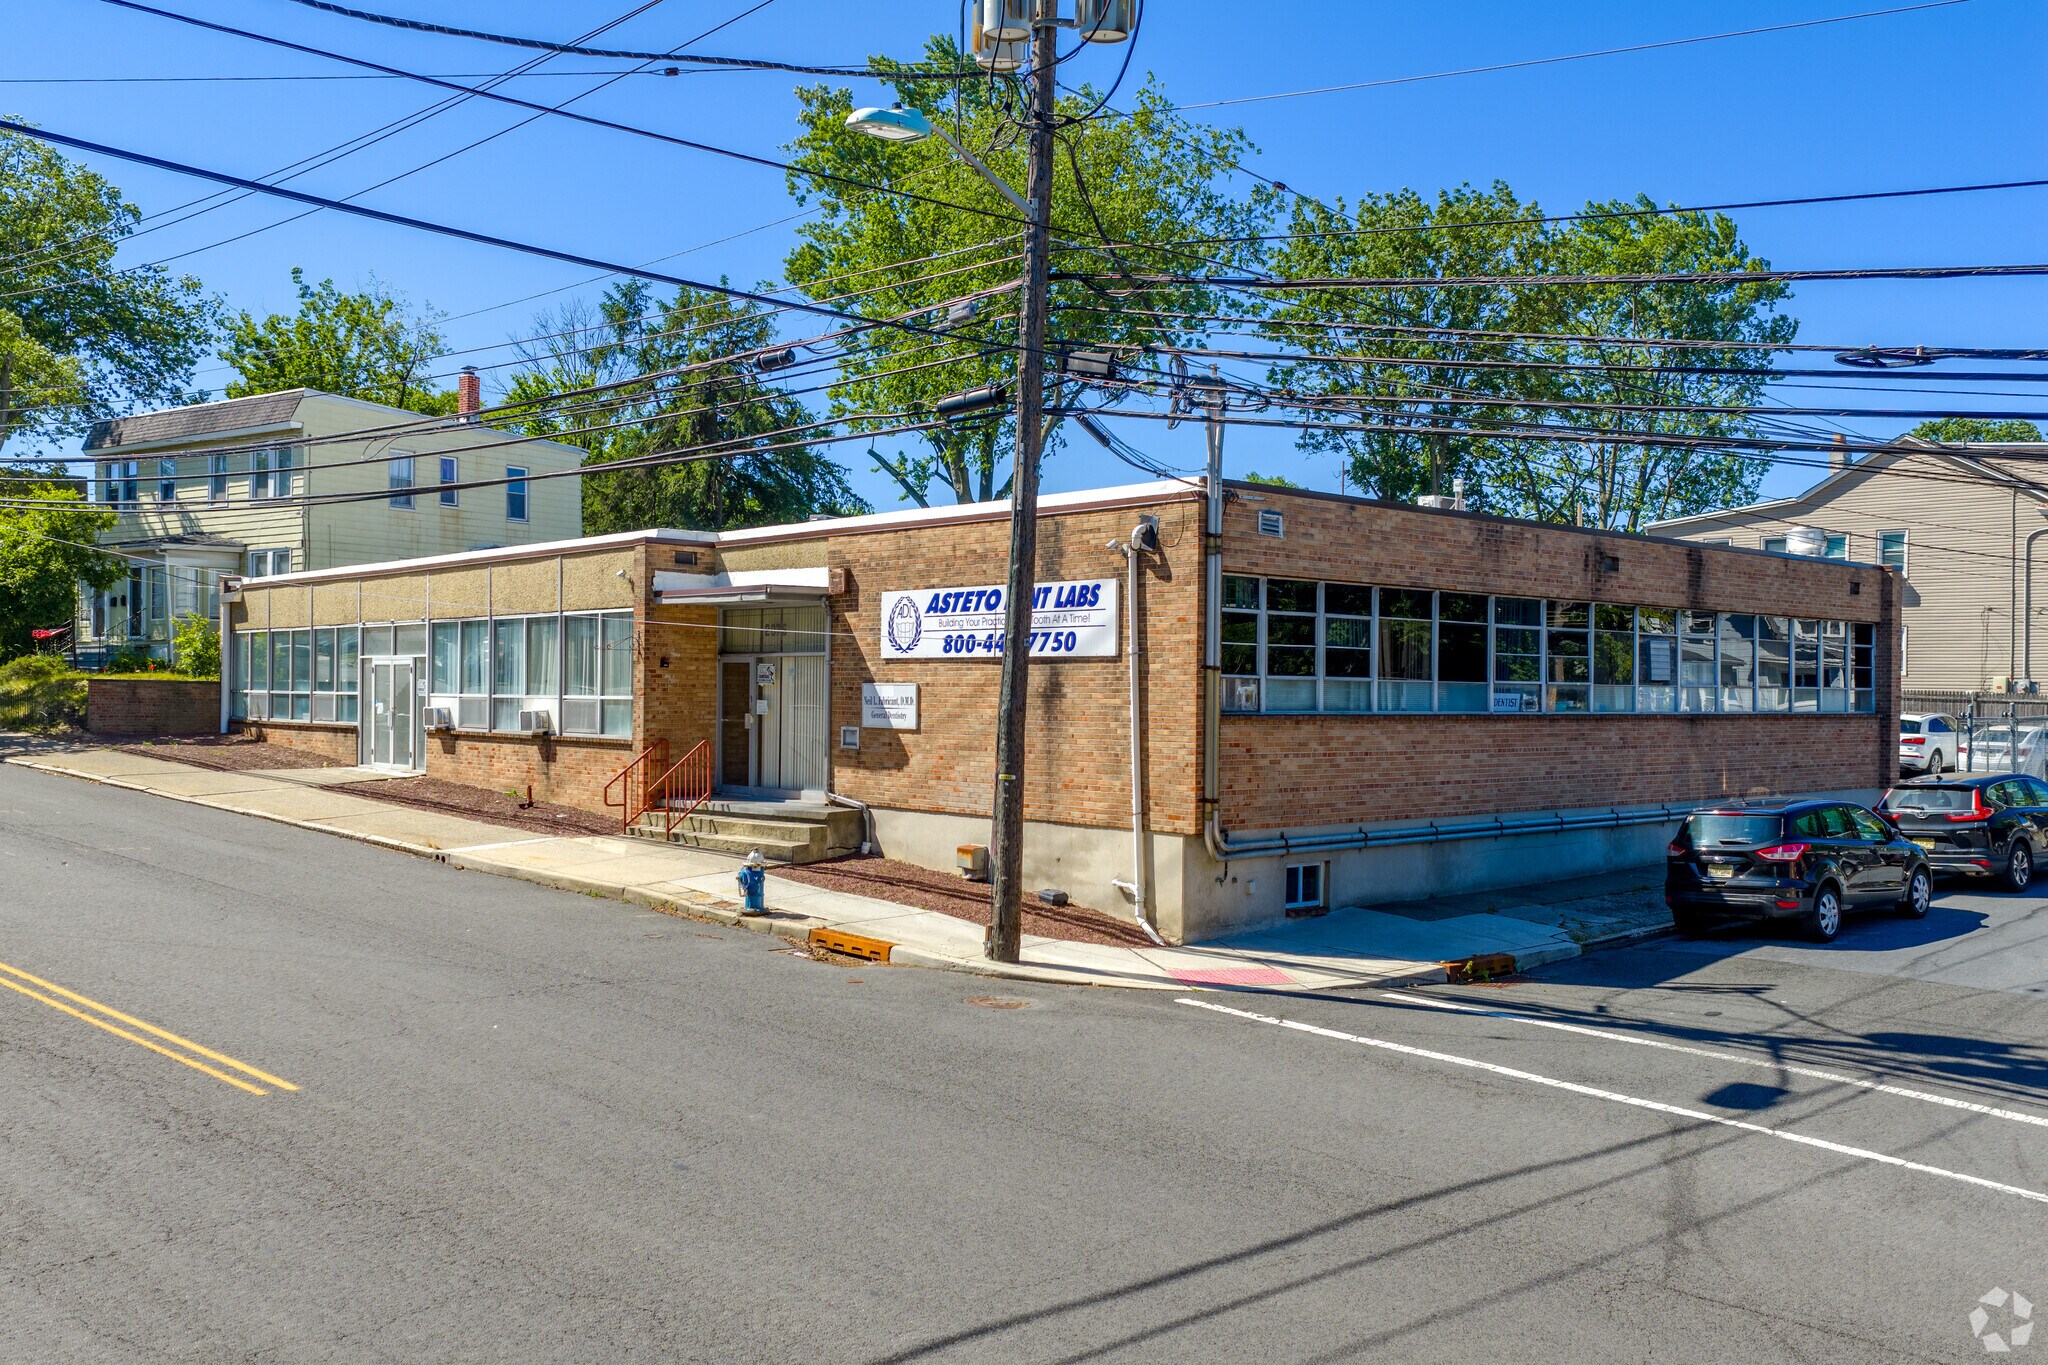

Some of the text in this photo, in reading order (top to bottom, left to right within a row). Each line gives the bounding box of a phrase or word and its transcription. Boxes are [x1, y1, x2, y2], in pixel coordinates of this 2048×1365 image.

[925, 588, 1002, 614] ASTETO
[1054, 583, 1101, 608] LABS
[938, 618, 964, 629] Building
[965, 617, 981, 627] Your
[981, 616, 1006, 627] Practic
[1052, 614, 1061, 623] At
[1061, 614, 1068, 623] A
[1069, 613, 1091, 623] Time!
[1493, 697, 1518, 708] DENTIST
[870, 710, 907, 721] General Dentistry
